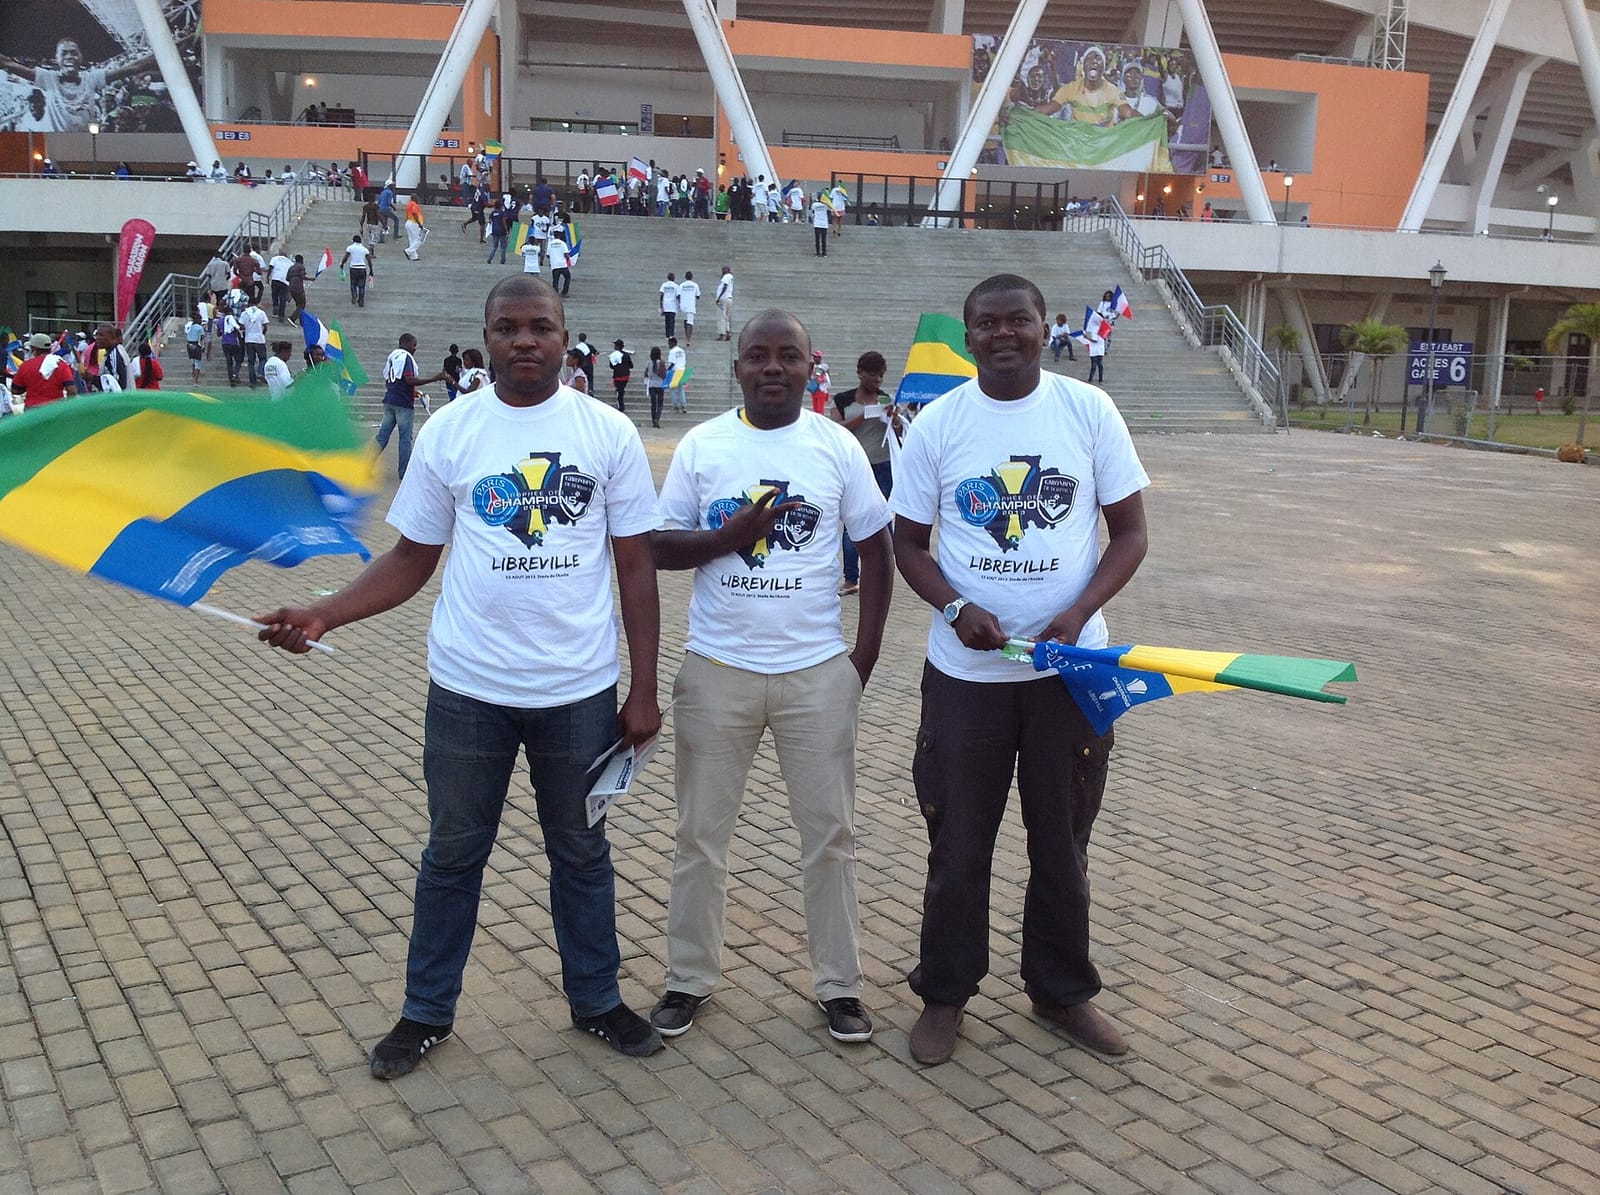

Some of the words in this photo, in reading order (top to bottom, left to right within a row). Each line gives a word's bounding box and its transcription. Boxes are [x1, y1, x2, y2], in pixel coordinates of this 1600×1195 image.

[1412, 358, 1448, 368] ACES
[1450, 357, 1466, 382] 6
[477, 479, 505, 496] PARIS
[958, 482, 985, 497] PARIS
[493, 496, 577, 509] CHAMPIONS
[711, 503, 735, 516] PARIS
[975, 499, 1056, 511] CHAMPIONS
[491, 554, 580, 572] LIBREVILLE
[969, 555, 1059, 575] LIBREVILLE
[720, 574, 803, 591] LIBREVILLE
